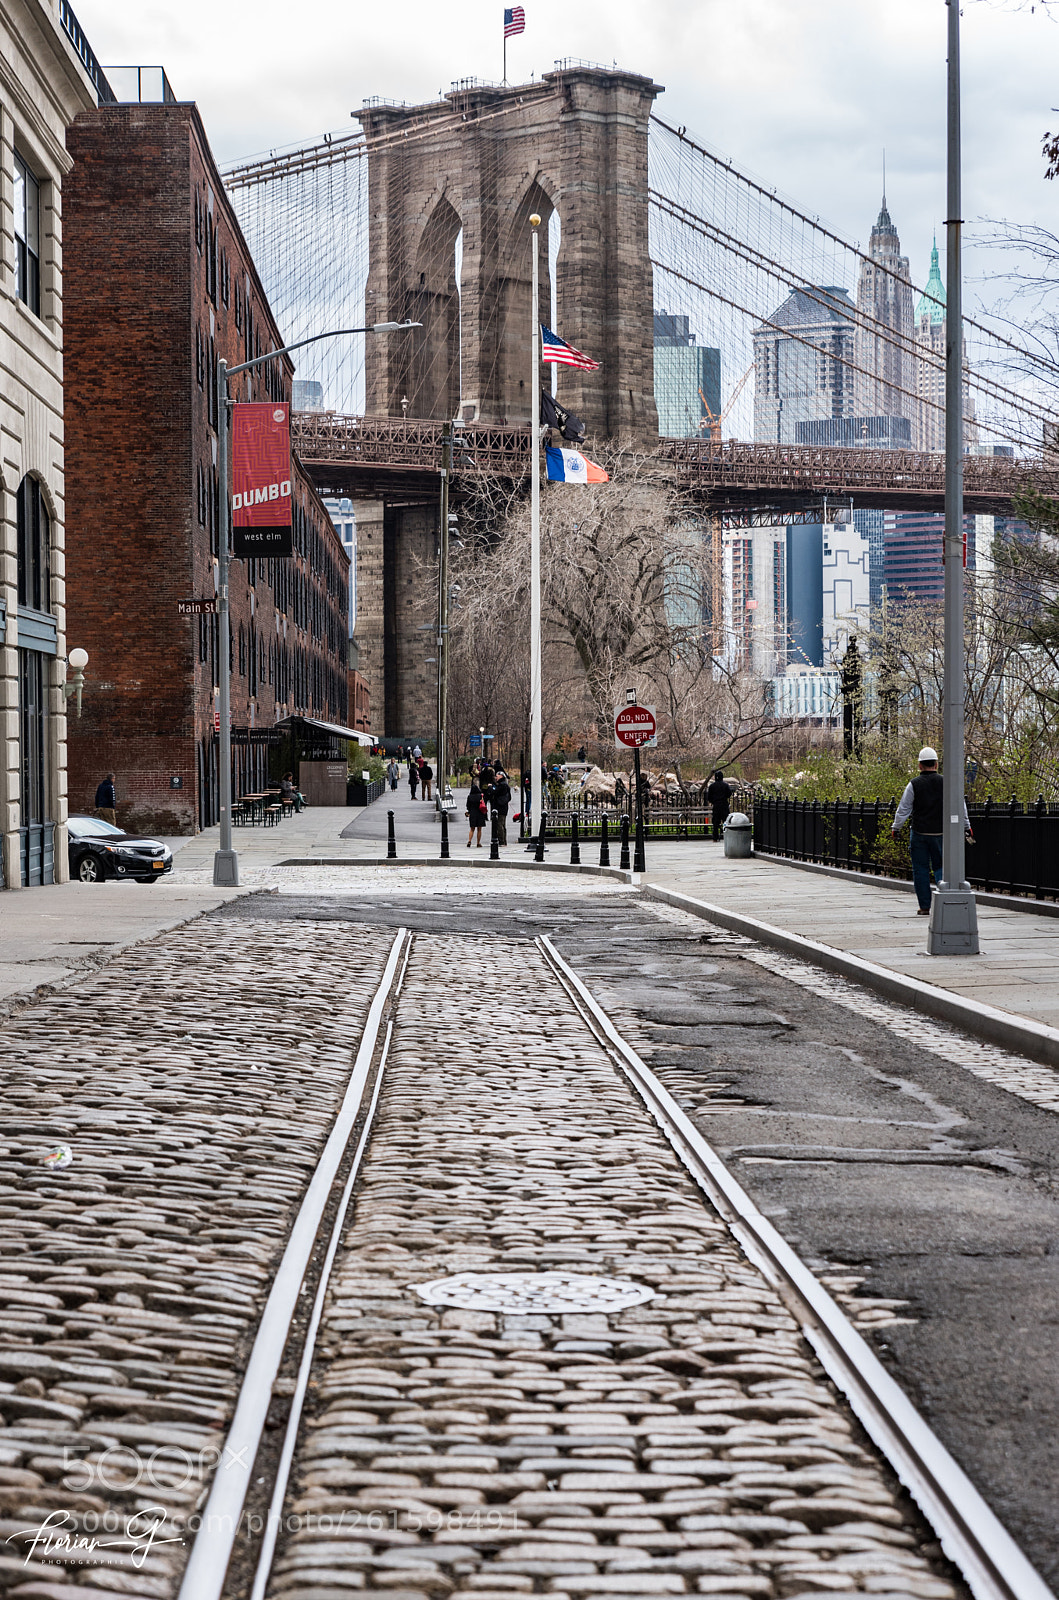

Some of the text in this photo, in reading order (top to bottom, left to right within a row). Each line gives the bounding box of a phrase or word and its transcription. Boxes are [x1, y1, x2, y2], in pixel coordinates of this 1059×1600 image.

[233, 480, 291, 510] DUMBO
[244, 532, 282, 541] west elm
[178, 602, 215, 613] Main St
[635, 713, 650, 721] NOT
[624, 732, 648, 740] ENTER
